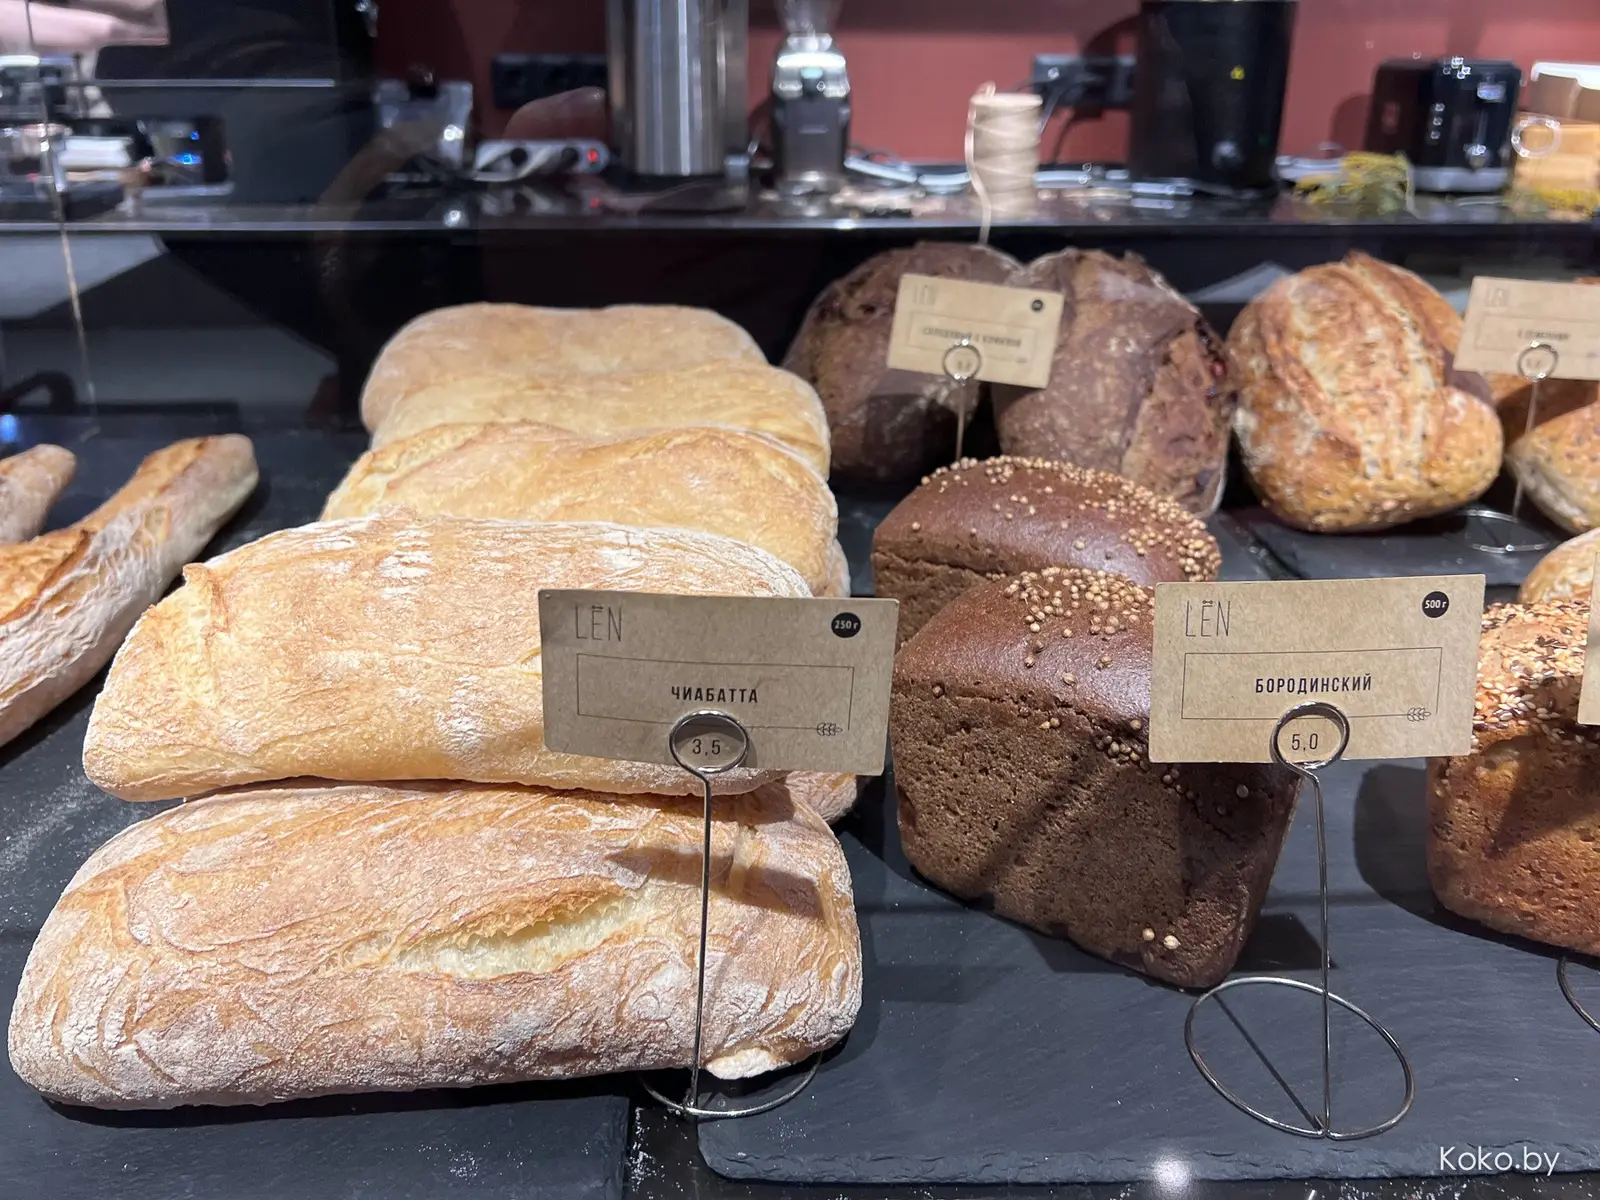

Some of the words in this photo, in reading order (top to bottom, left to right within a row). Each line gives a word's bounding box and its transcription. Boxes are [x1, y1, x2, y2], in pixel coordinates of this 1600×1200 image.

[1424, 599, 1441, 609] 500
[834, 620, 852, 630] 250
[1255, 673, 1372, 694] БОРОДИНСКИЙ
[671, 686, 758, 703] ЧИАБАТТА
[691, 738, 721, 757] 3,5
[1291, 732, 1319, 752] 5,0
